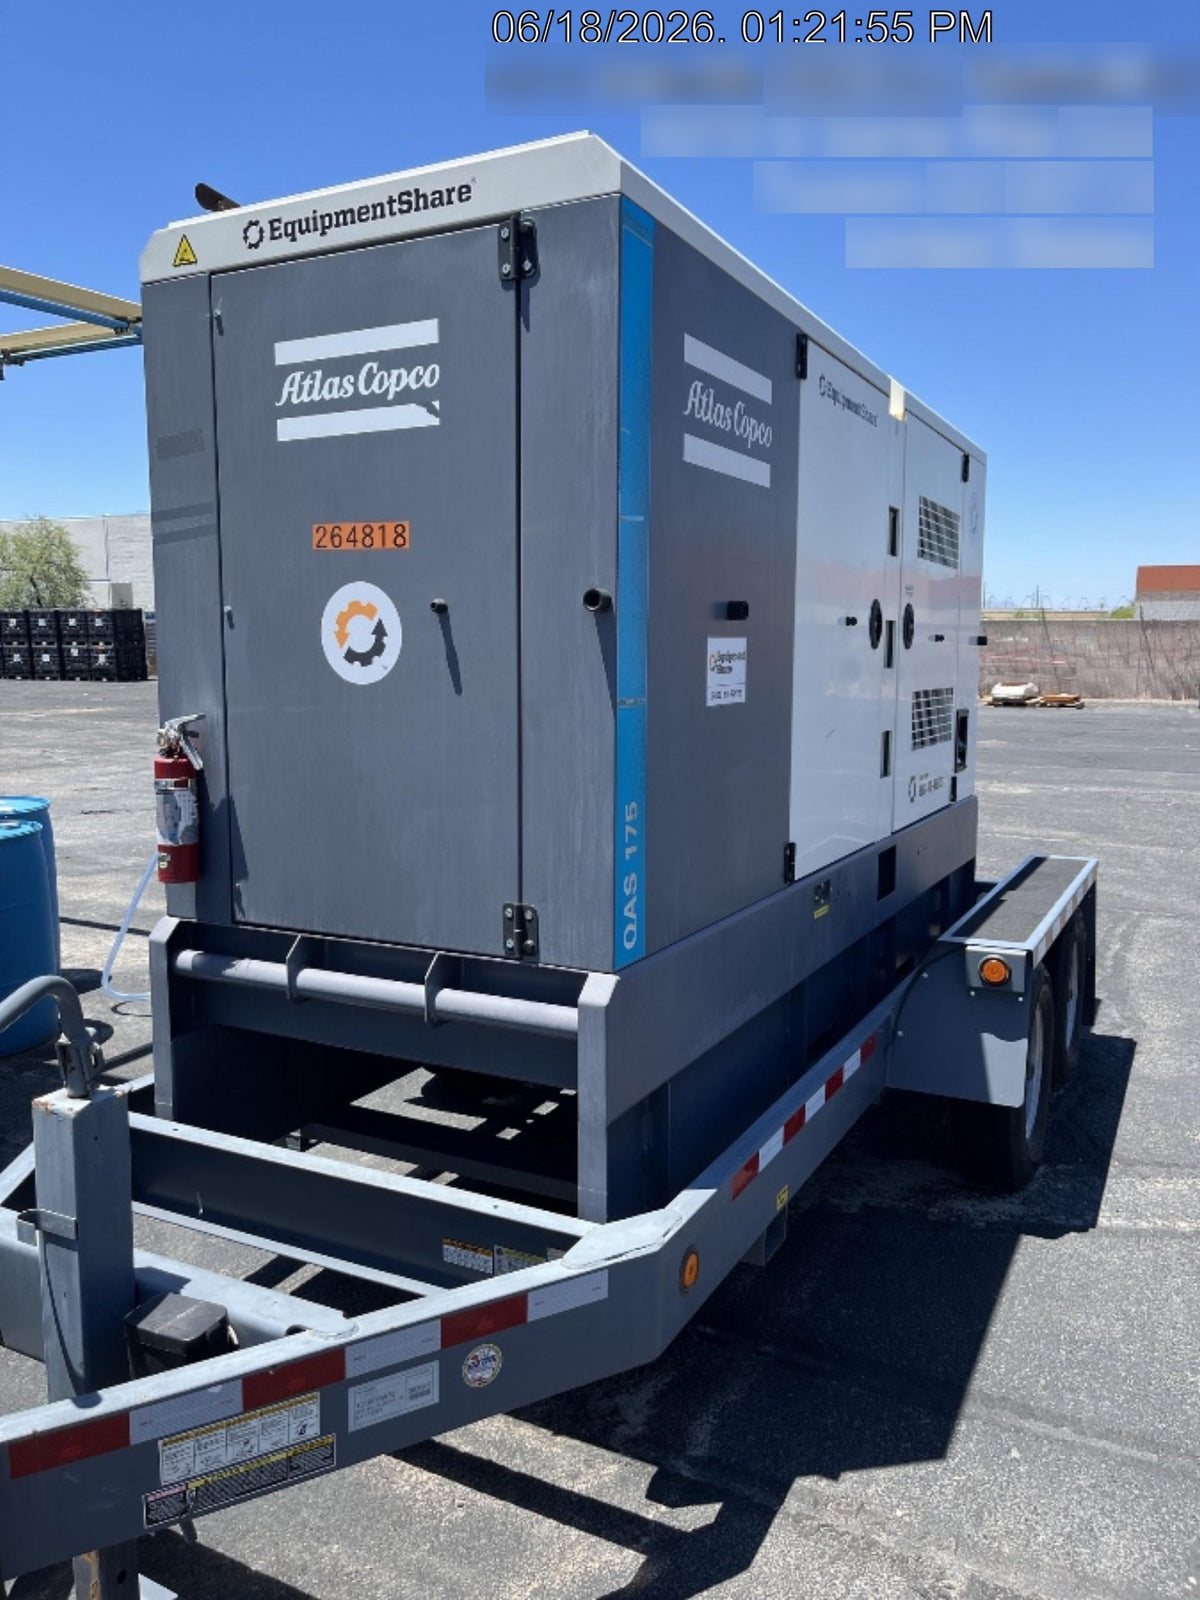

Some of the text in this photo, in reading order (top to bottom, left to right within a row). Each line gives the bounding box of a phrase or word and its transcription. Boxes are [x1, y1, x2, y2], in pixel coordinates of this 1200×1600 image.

[268, 183, 472, 242] EquipmentShare
[275, 361, 440, 406] Atlas Copco
[683, 380, 772, 449] Atlas Copco
[315, 524, 406, 548] 264818
[623, 801, 638, 950] QAS 175
